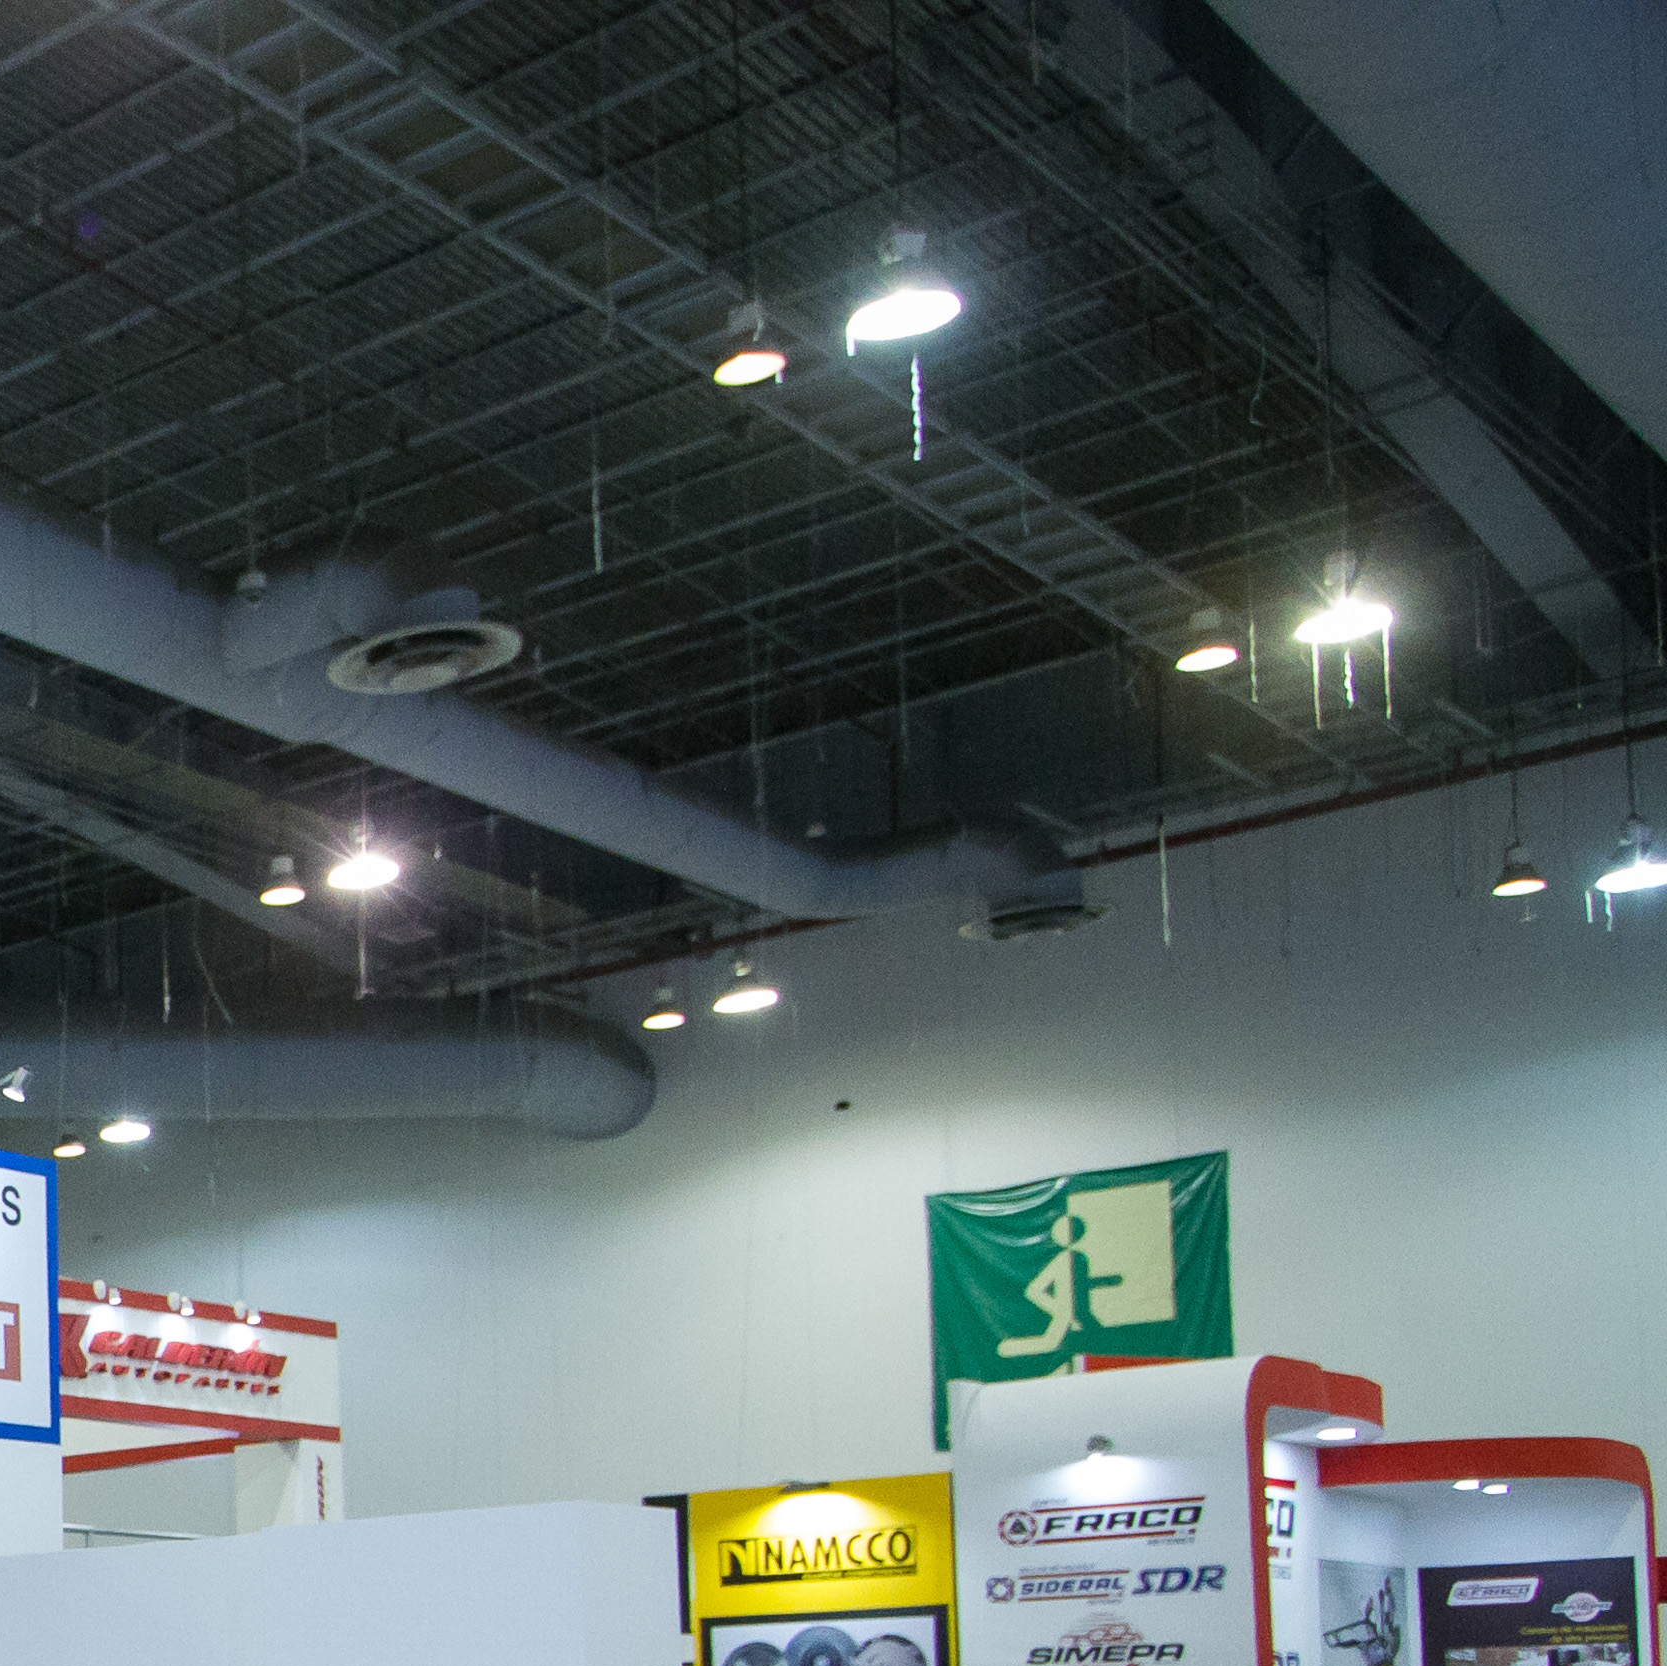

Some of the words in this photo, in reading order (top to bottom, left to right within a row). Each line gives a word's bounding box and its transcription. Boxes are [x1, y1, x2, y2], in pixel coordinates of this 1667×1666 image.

[1043, 1505, 1204, 1536] FRACO
[764, 1530, 911, 1575] NAMCCO
[1133, 1564, 1229, 1596] SDR
[1027, 1643, 1186, 1665] SIMEPA
